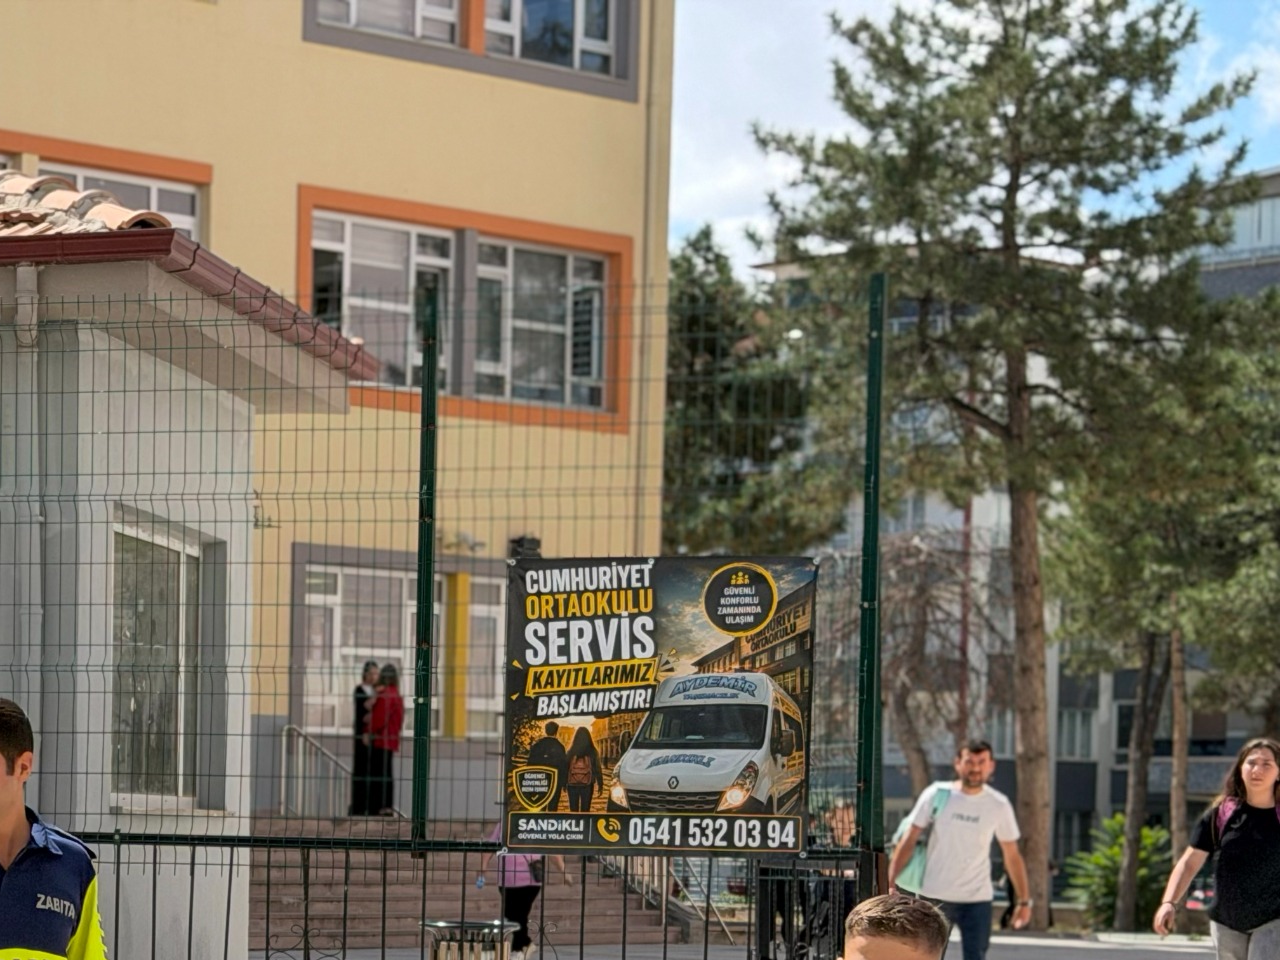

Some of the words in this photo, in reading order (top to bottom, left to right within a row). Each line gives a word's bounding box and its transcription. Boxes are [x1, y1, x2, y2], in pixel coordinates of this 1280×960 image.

[525, 562, 653, 594] CUMHURİYET
[724, 586, 755, 595] GÜVENLİ
[525, 589, 653, 619] ORTAOKULU
[717, 606, 762, 615] ZAMANINDA
[719, 596, 759, 605] KONFORLU
[725, 615, 754, 625] ULAŞIM
[524, 611, 655, 665] SERVİS
[531, 663, 653, 690] KAYITLARIMIZ
[669, 676, 757, 698] AYDEMİR
[536, 688, 652, 716] BAŞLAMIŞTIR!
[628, 817, 682, 846] 0541
[688, 818, 728, 847] 532
[733, 819, 761, 848] 03
[767, 820, 796, 849] 94
[35, 893, 76, 920] ZABITA
